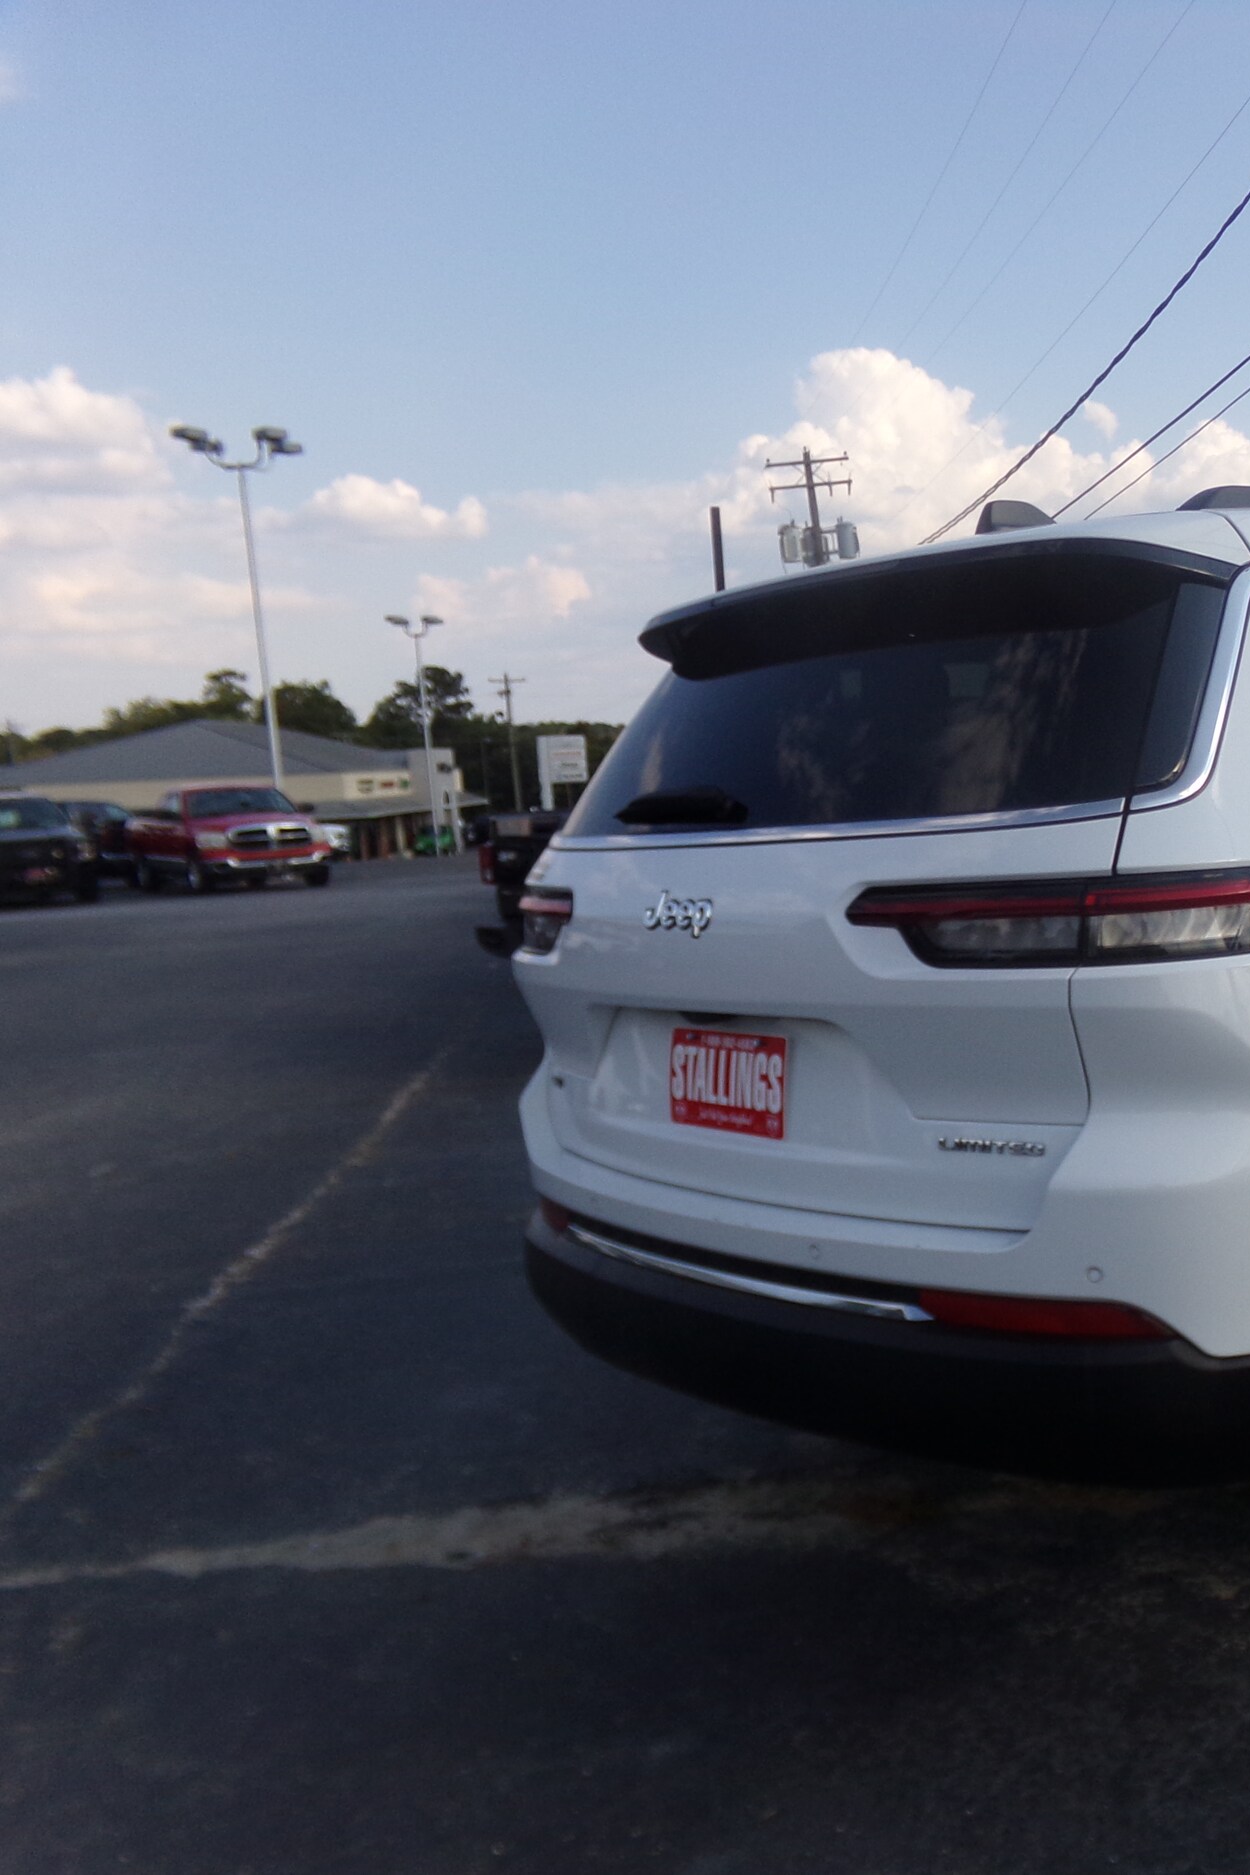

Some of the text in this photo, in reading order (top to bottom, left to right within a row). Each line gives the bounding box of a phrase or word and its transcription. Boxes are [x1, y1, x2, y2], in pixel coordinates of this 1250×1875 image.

[641, 890, 712, 938] Jeep
[672, 1045, 782, 1114] STALLINGS
[938, 1138, 1045, 1157] LIMITED
